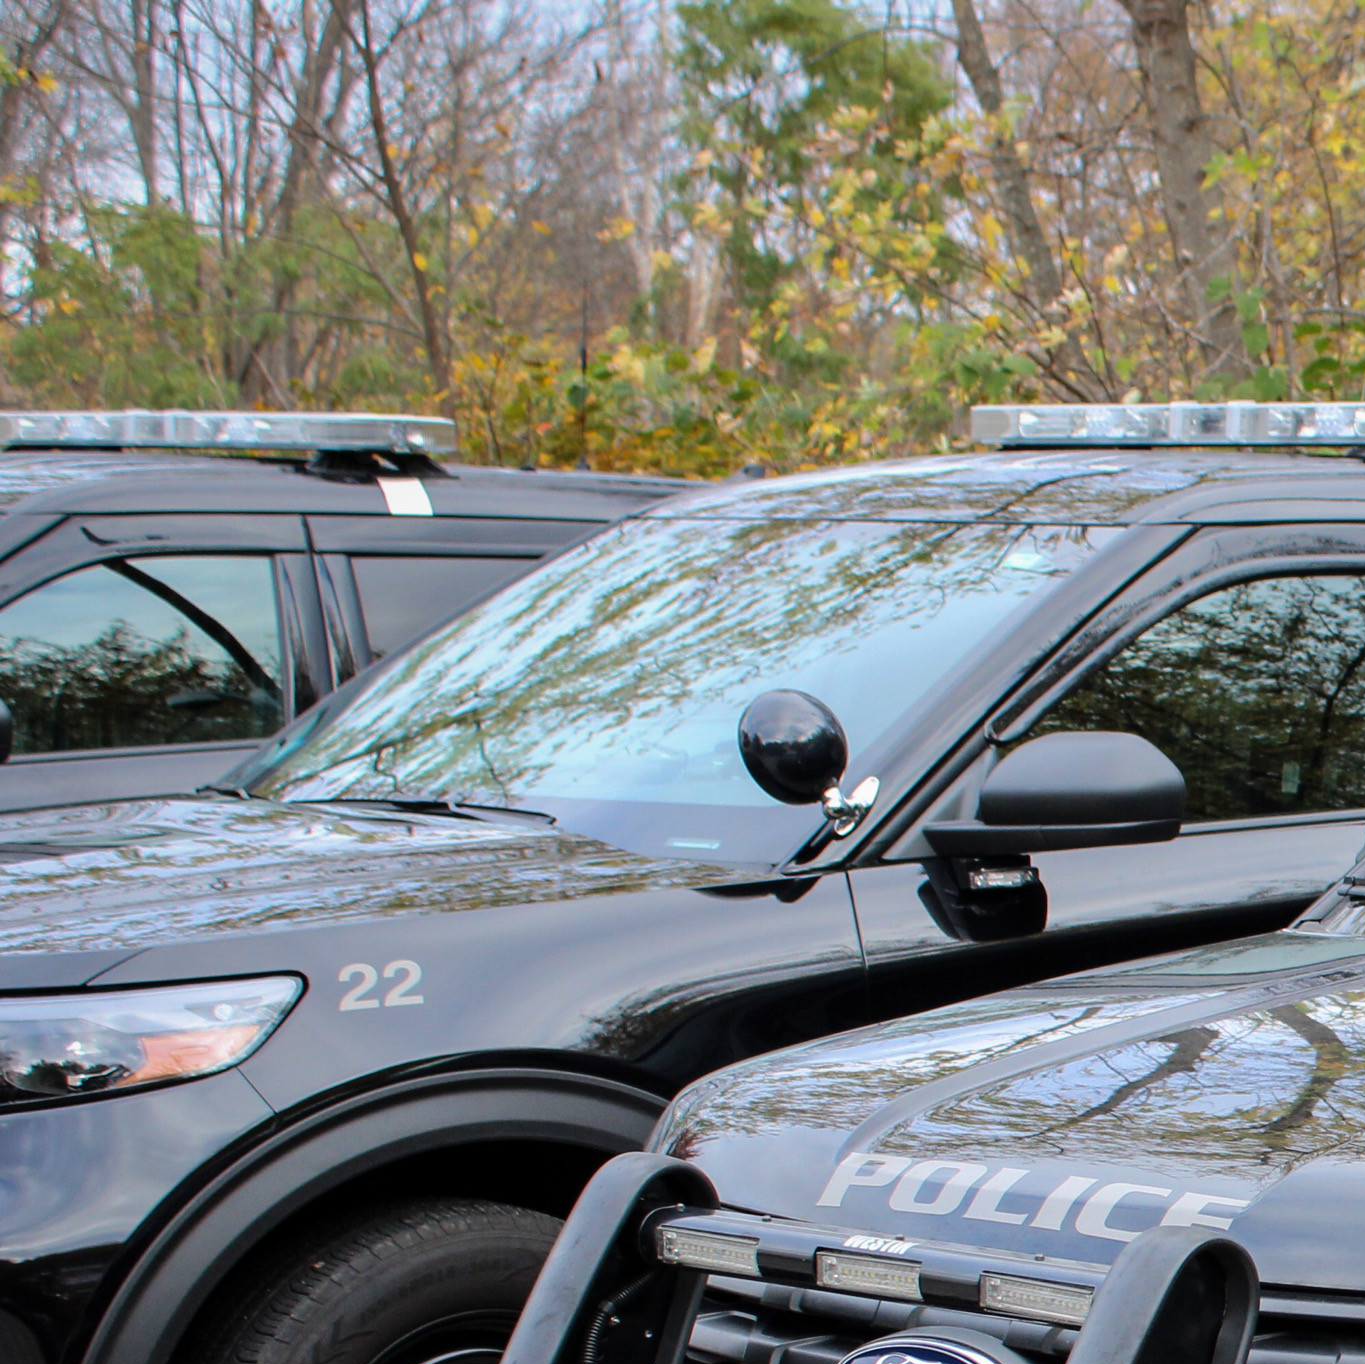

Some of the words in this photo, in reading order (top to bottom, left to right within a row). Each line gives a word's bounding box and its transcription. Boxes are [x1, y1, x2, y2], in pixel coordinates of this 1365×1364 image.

[337, 959, 425, 1013] 22
[816, 1152, 1252, 1242] POLICE
[843, 1234, 922, 1255] WESTIN
